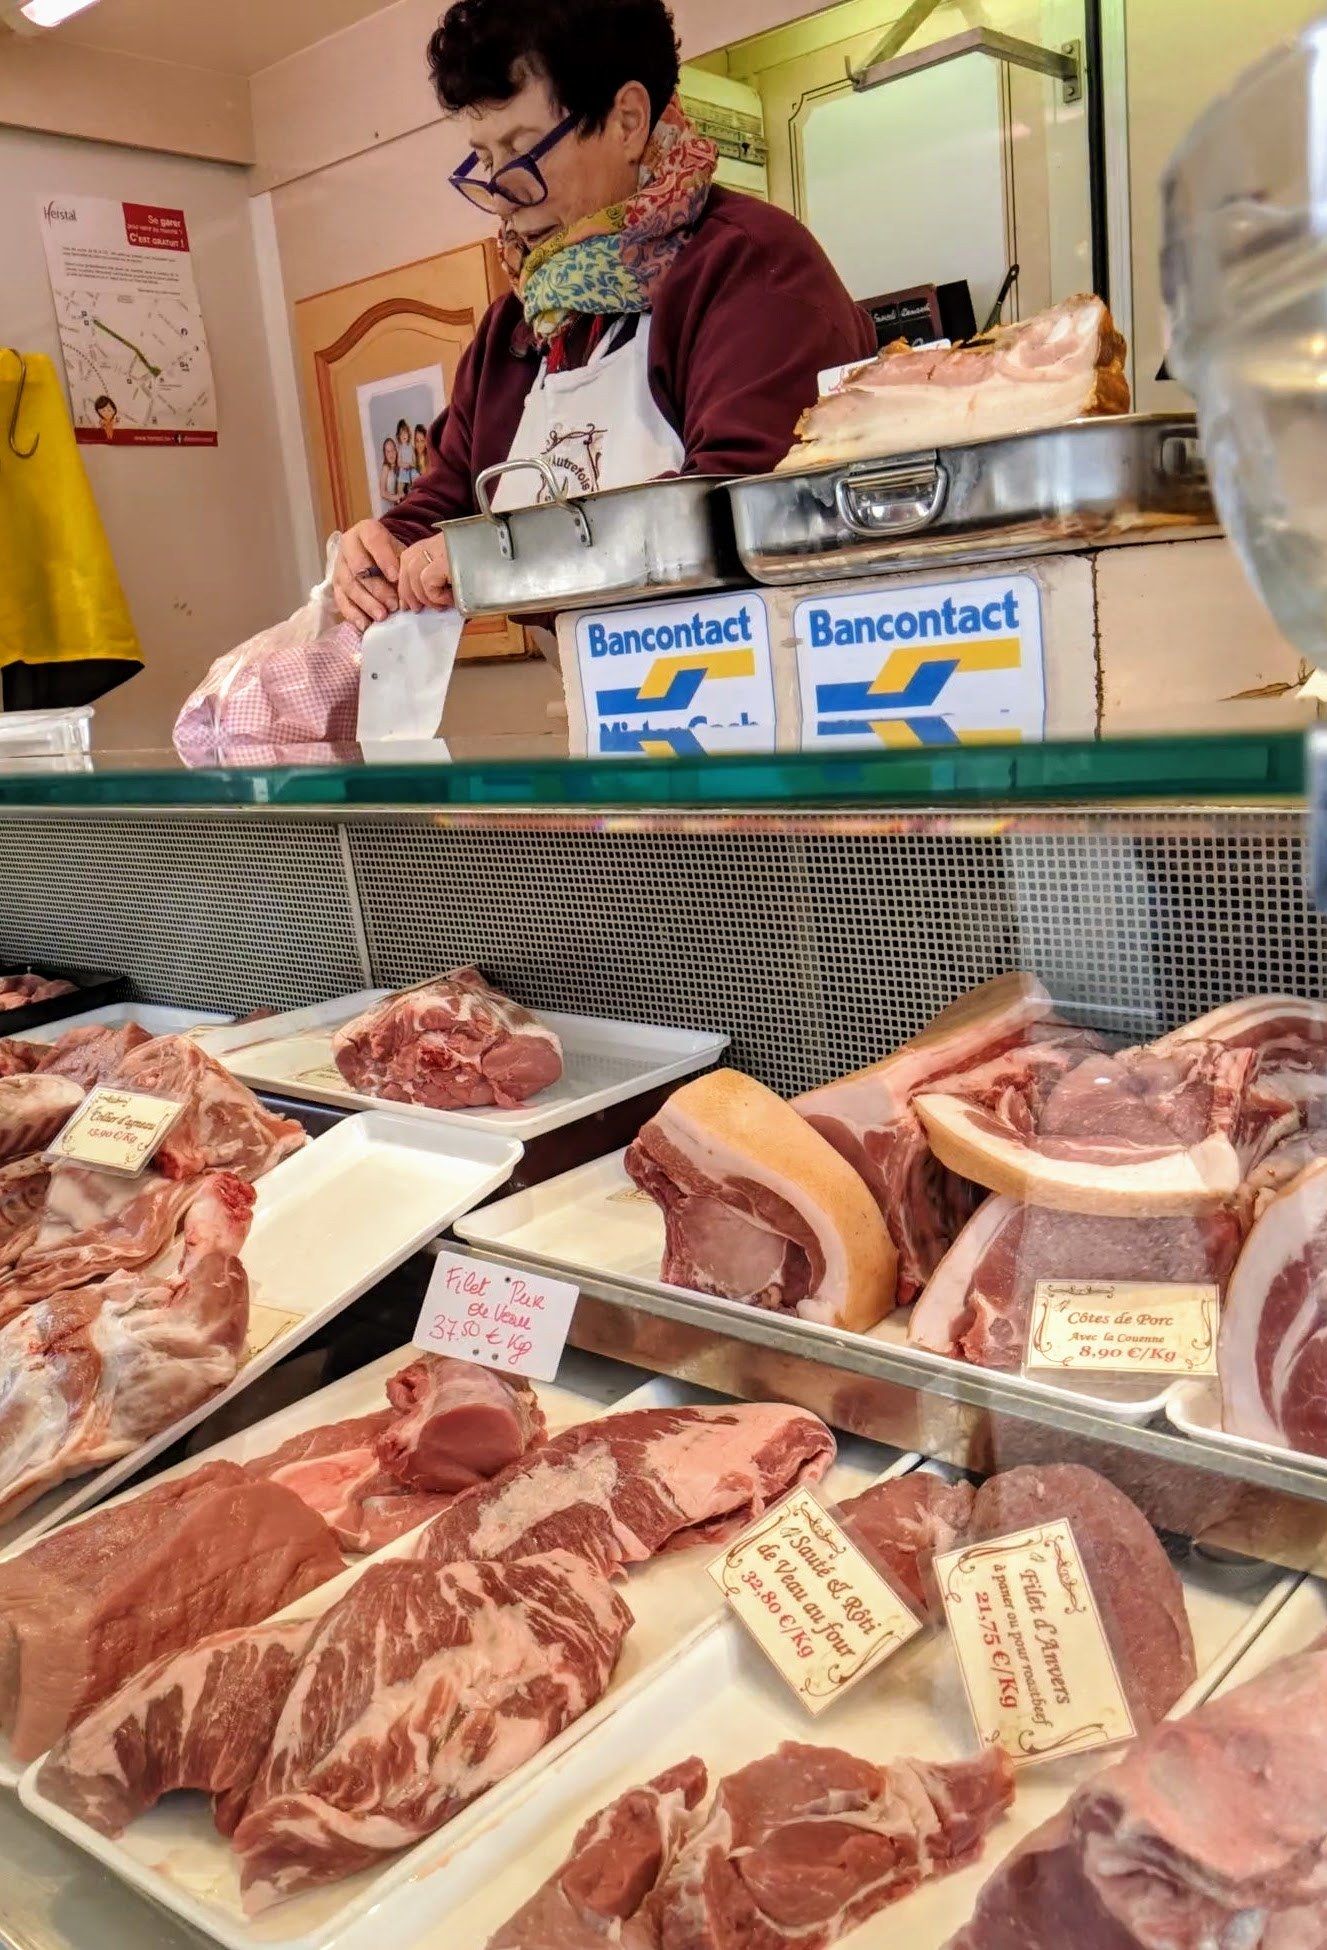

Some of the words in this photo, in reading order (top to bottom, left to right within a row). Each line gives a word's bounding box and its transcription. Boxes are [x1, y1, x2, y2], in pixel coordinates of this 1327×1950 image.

[44, 201, 77, 228] Herstal
[147, 214, 159, 225] Se
[160, 218, 181, 228] garer
[588, 606, 752, 658] Bancontact
[809, 589, 1020, 648] Bancontact
[446, 1266, 491, 1297] Filet
[467, 1303, 489, 1319] de
[494, 1303, 531, 1330] Veau
[1067, 1312, 1110, 1325] Côtes
[1113, 1311, 1133, 1325] de
[1136, 1313, 1175, 1327] Porc
[507, 1333, 532, 1365] Kg
[1068, 1331, 1098, 1342] Avec
[1103, 1331, 1114, 1341] la
[1117, 1333, 1165, 1343] Couenne
[1079, 1345, 1123, 1359] 8,90
[1127, 1346, 1177, 1363] €/Kg
[757, 1543, 780, 1562] de
[774, 1558, 808, 1601] Veau
[992, 1564, 1007, 1573] à
[789, 1535, 836, 1578] Sauté
[841, 1595, 882, 1635] Rôti
[741, 1570, 781, 1614] 32,80
[779, 1614, 814, 1659] €/Kg
[803, 1602, 826, 1624] au
[1007, 1612, 1018, 1629] ou
[811, 1622, 856, 1657] four
[975, 1591, 1001, 1646] 21,75
[990, 1650, 1019, 1709] €/Kg
[1007, 1630, 1029, 1664] pour
[1019, 1568, 1047, 1613] Filet
[1033, 1618, 1070, 1705] d'Anvers
[1022, 1664, 1053, 1728] roastbeef
